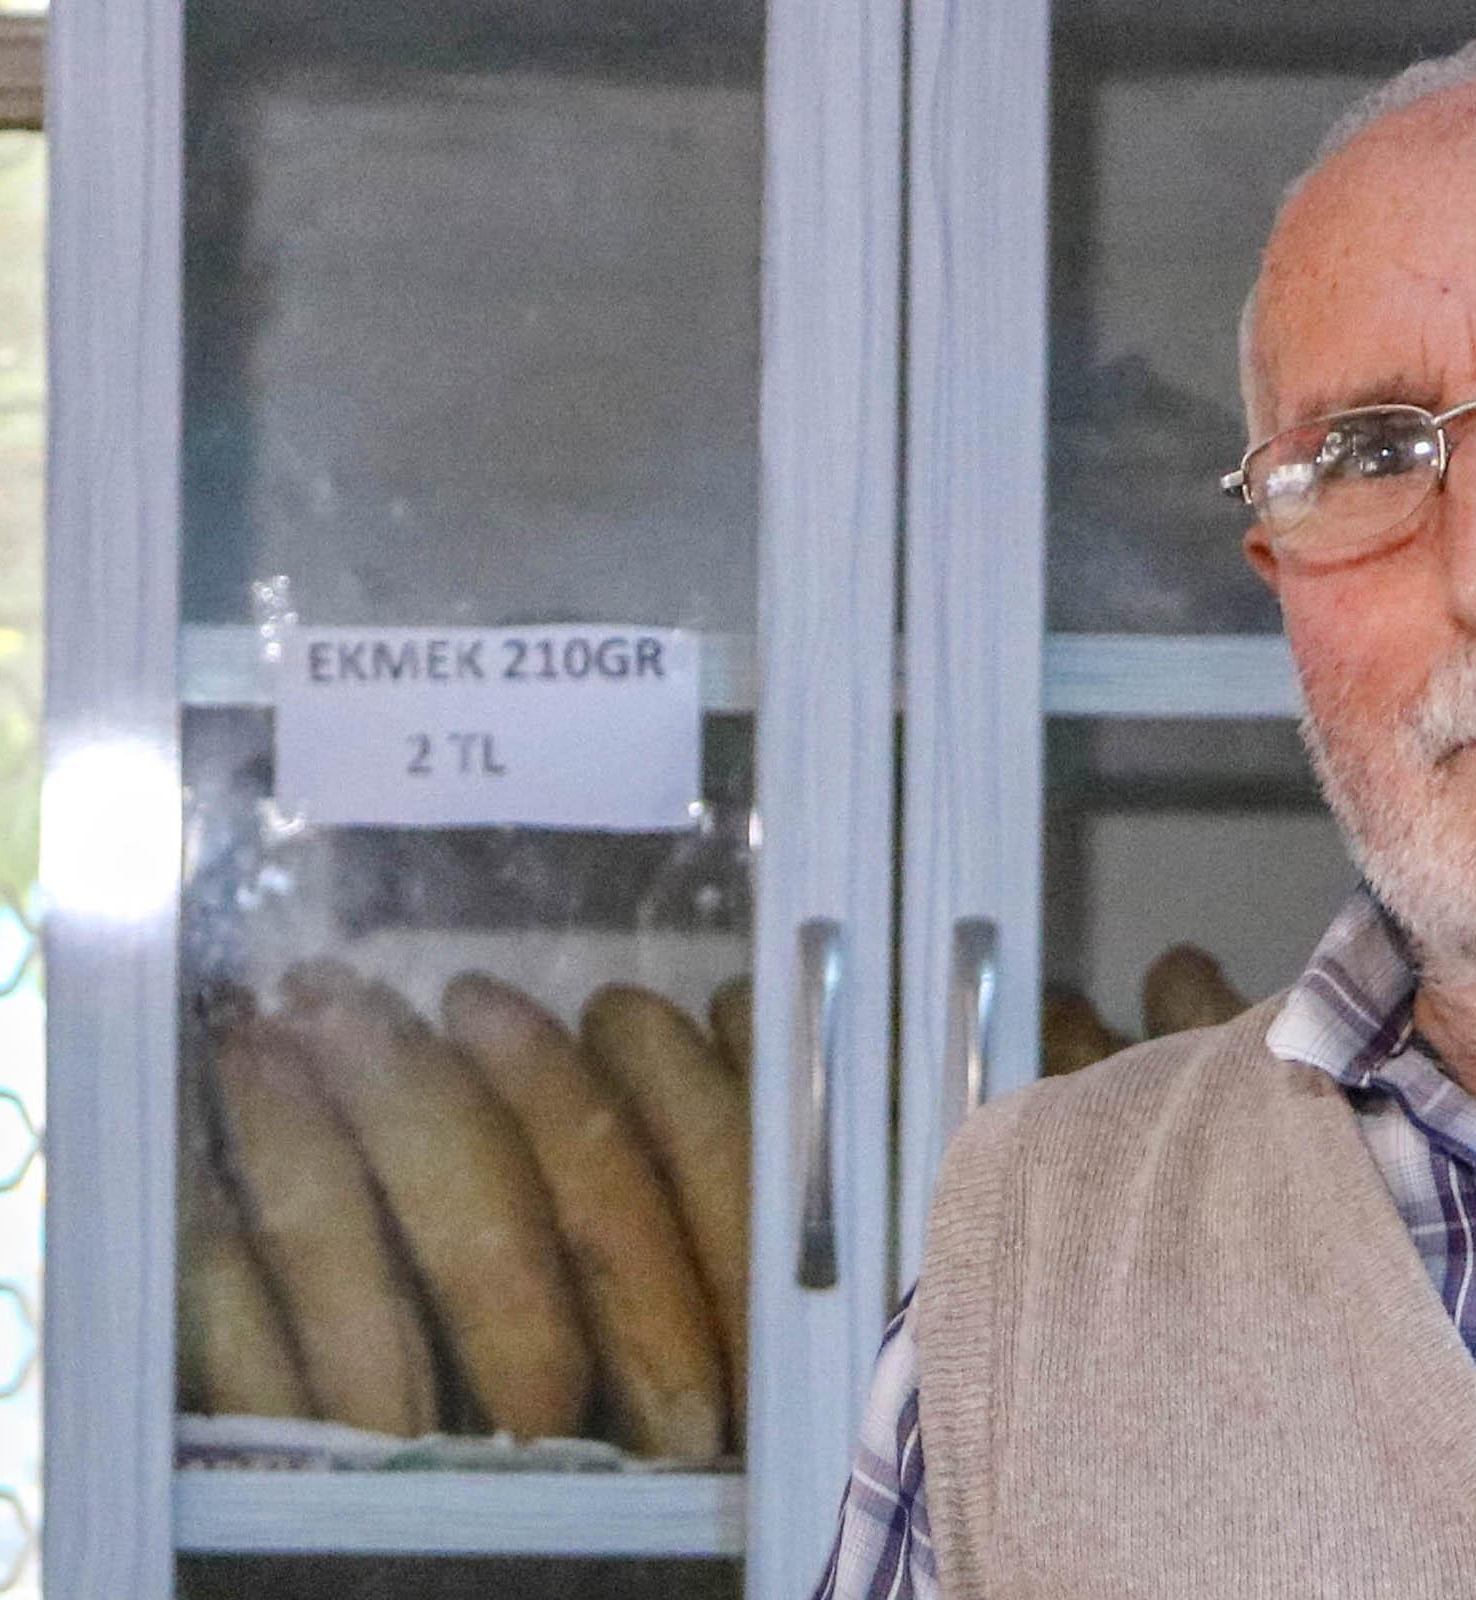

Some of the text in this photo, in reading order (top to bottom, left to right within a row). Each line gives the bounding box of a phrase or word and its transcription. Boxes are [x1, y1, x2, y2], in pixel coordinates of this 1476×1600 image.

[308, 637, 666, 682] EKMEK 210GR
[407, 733, 507, 776] 2 TL
